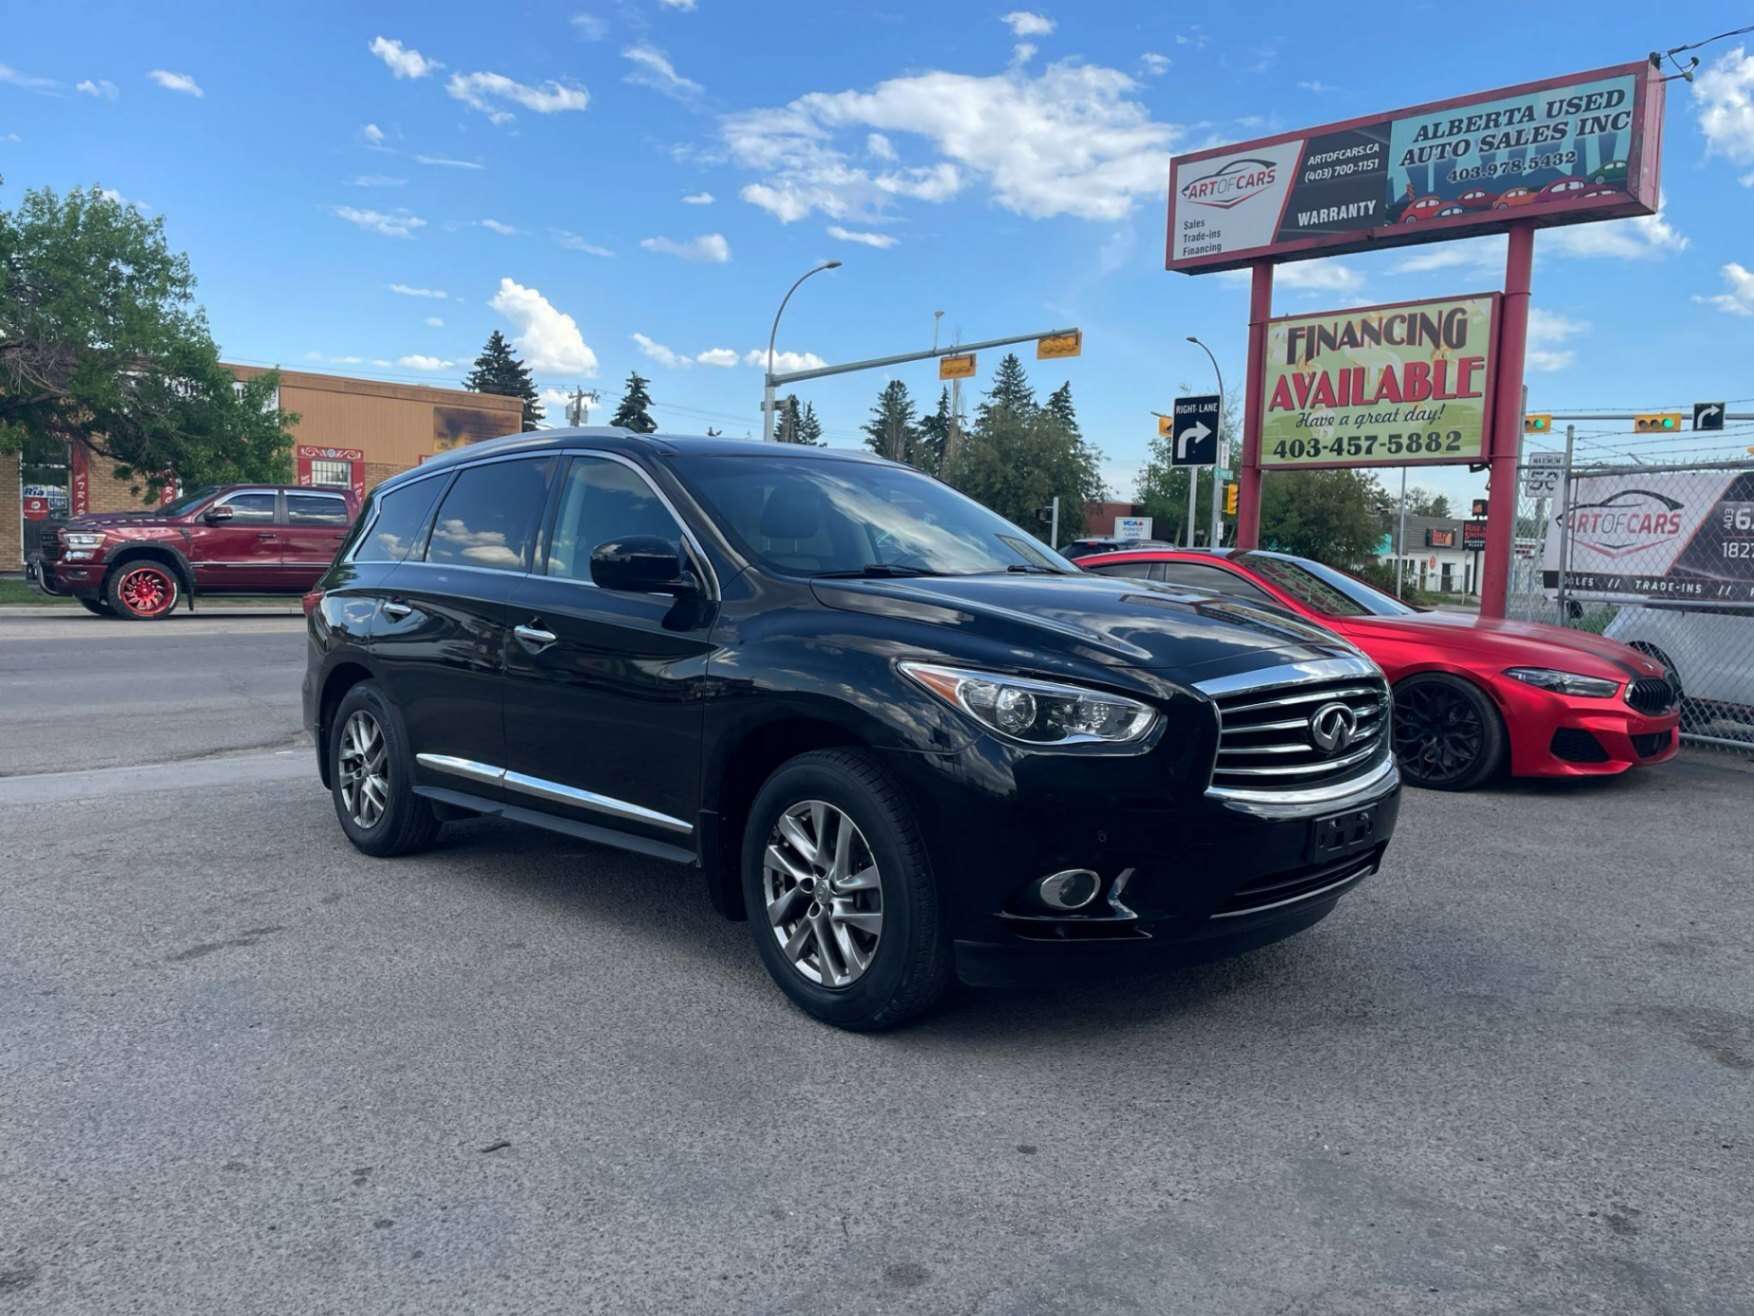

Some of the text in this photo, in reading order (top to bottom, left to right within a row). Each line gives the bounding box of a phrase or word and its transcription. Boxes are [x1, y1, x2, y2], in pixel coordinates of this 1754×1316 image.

[1413, 89, 1625, 143] ALBERTA USED
[1399, 111, 1632, 167] AUTO SALES INC
[1307, 143, 1380, 166] ARTOFCARS.CA
[1447, 151, 1577, 182] 403.978.5432
[1304, 158, 1379, 184] (403) 700-1151
[1188, 169, 1276, 200] ARTOFCARS
[1183, 219, 1205, 231] Sales
[1298, 200, 1377, 227] WARRANTY
[1183, 230, 1221, 244] Trade-ins
[1183, 243, 1222, 256] Financing
[1286, 307, 1468, 365] FINANCING
[1268, 356, 1485, 412] AVAILABLE
[1176, 402, 1219, 414] RIGHT LANE
[1295, 403, 1446, 430] Have a great day!
[1273, 431, 1462, 459] 403-457-5882
[1735, 508, 1754, 530] 6
[1722, 542, 1754, 558] 182
[1565, 577, 1595, 588] LES
[1635, 580, 1702, 594] TRADE-INS
